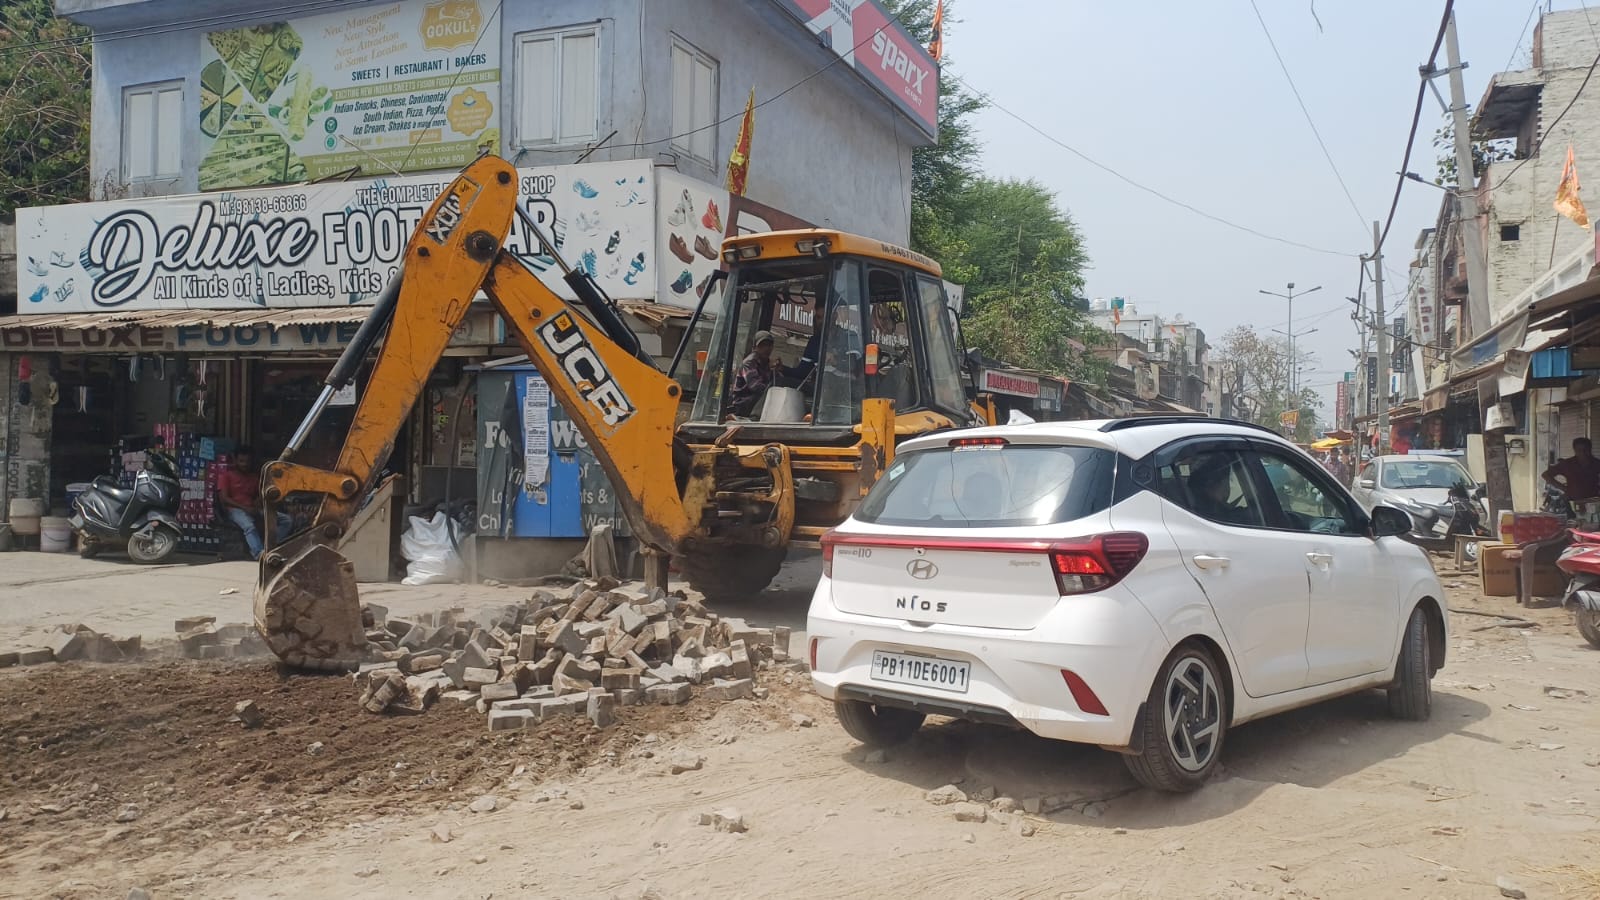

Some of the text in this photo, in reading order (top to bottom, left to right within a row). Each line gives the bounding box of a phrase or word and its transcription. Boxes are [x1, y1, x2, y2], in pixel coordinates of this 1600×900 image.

[352, 54, 486, 81] SWEETS RESTAURANT BAKERS
[871, 28, 928, 94] sparx
[356, 175, 556, 206] THE COMPLETE SHOP
[88, 200, 318, 306] Deluxe
[154, 275, 176, 299] All
[181, 274, 228, 298] Kinds
[233, 273, 251, 297] of
[268, 270, 335, 299] Ladies,
[340, 266, 382, 295] Kids
[779, 303, 792, 321] All
[794, 304, 814, 327] Kind
[177, 324, 281, 347] FOOT
[300, 322, 359, 346] WE
[542, 319, 631, 426] JCB
[881, 657, 966, 686] PB11DE6001
